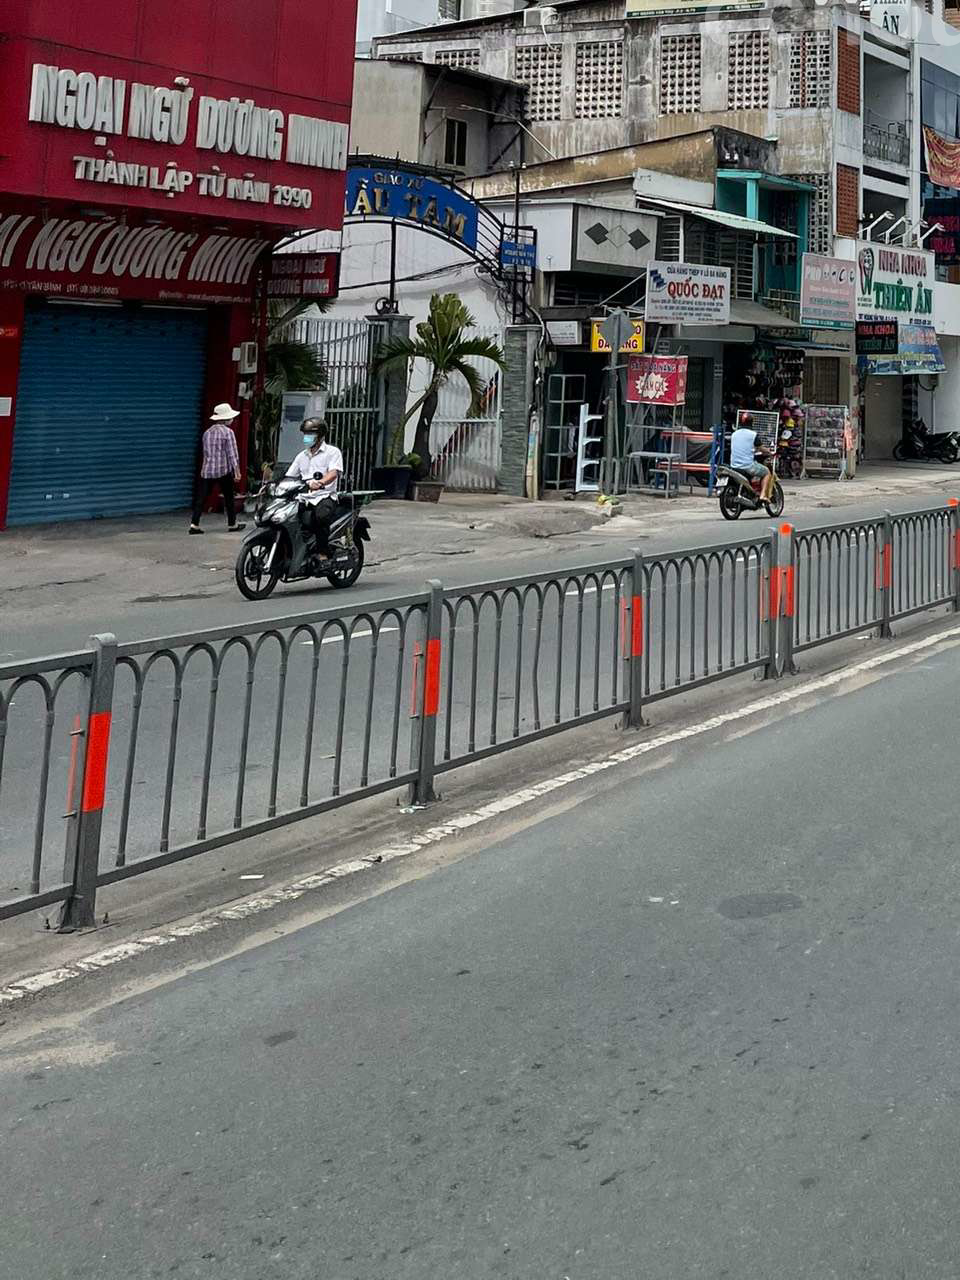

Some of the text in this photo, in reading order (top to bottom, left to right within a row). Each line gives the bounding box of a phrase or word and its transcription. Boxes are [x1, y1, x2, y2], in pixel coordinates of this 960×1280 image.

[882, 11, 899, 35] ÂN
[29, 63, 349, 172] NGOẠI NGỮ DƯƠNG MINH
[73, 151, 312, 210] THÀNH LẬP TỪ NĂM 1990
[92, 222, 199, 280] DƯƠNG
[188, 233, 271, 284] MINH
[879, 250, 899, 272] NHA
[901, 254, 927, 277] KHOA
[668, 276, 725, 301] QUỐC ĐẠT
[873, 278, 913, 312] THIÊN
[914, 281, 934, 314] ÂN
[857, 323, 896, 335] NHA KHOA
